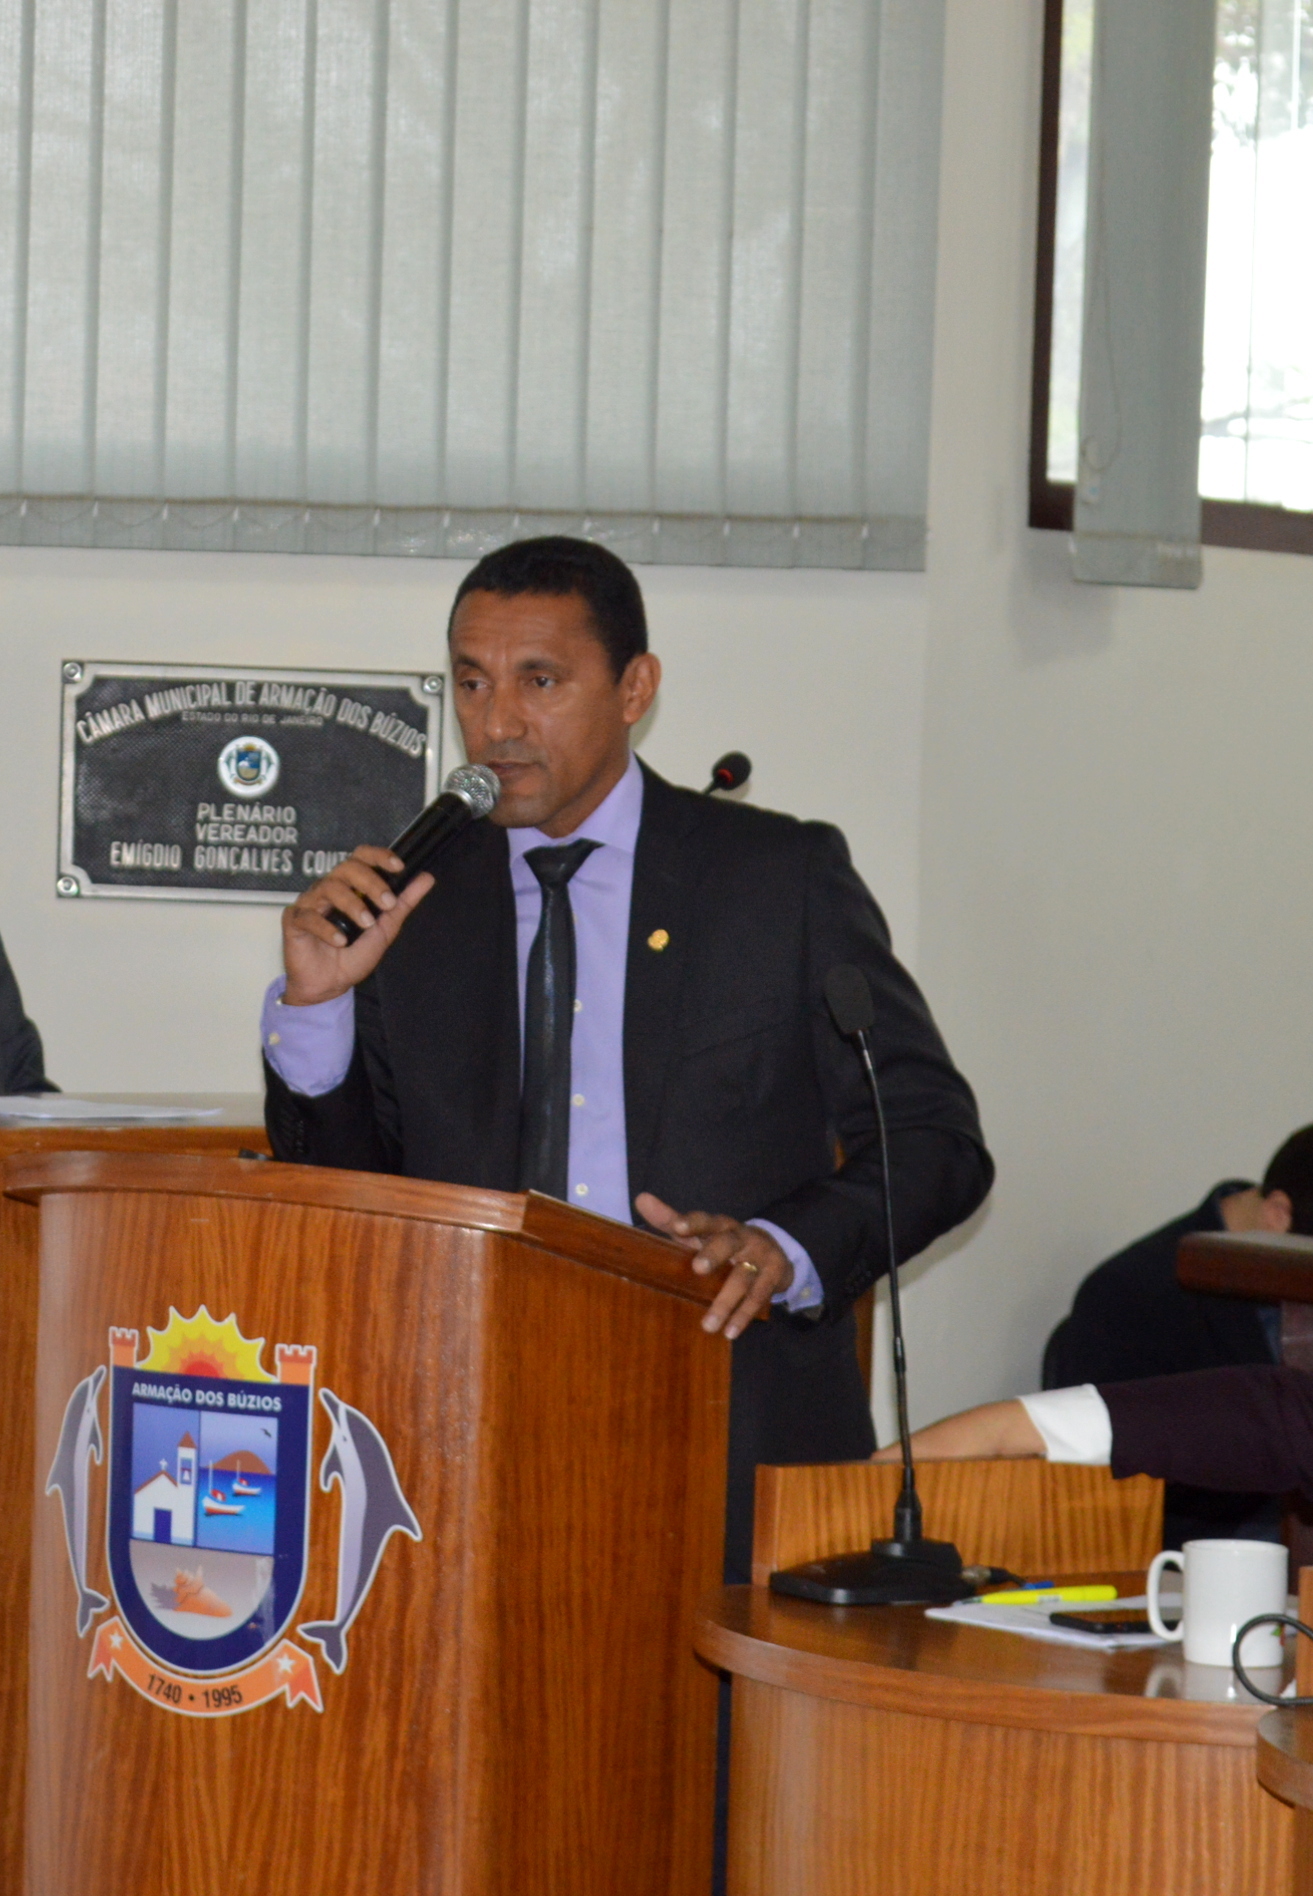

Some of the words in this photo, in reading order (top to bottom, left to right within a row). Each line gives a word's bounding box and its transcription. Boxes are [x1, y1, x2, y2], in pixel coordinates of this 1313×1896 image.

[76, 698, 146, 745] CÂMARA
[145, 682, 233, 722] MUNICIPAL
[234, 681, 257, 706] DE
[258, 682, 337, 718] ARMAÇÃO
[336, 697, 373, 732] DOS
[369, 711, 426, 759] BÚZIOS
[181, 710, 221, 723] ESTADO
[224, 712, 238, 723] DO
[241, 713, 259, 724] RIO
[262, 714, 276, 725] DE
[280, 715, 324, 727] JANEIRO
[197, 802, 297, 824] PLENÁRIO
[195, 823, 298, 844] VEREADOR
[302, 849, 353, 877] COUT
[132, 1382, 193, 1404] ARMAÇÃO
[195, 1390, 224, 1406] DOS
[227, 1390, 282, 1412] BÚZIOS
[148, 1673, 183, 1704] 1740
[203, 1685, 243, 1708] 1995
